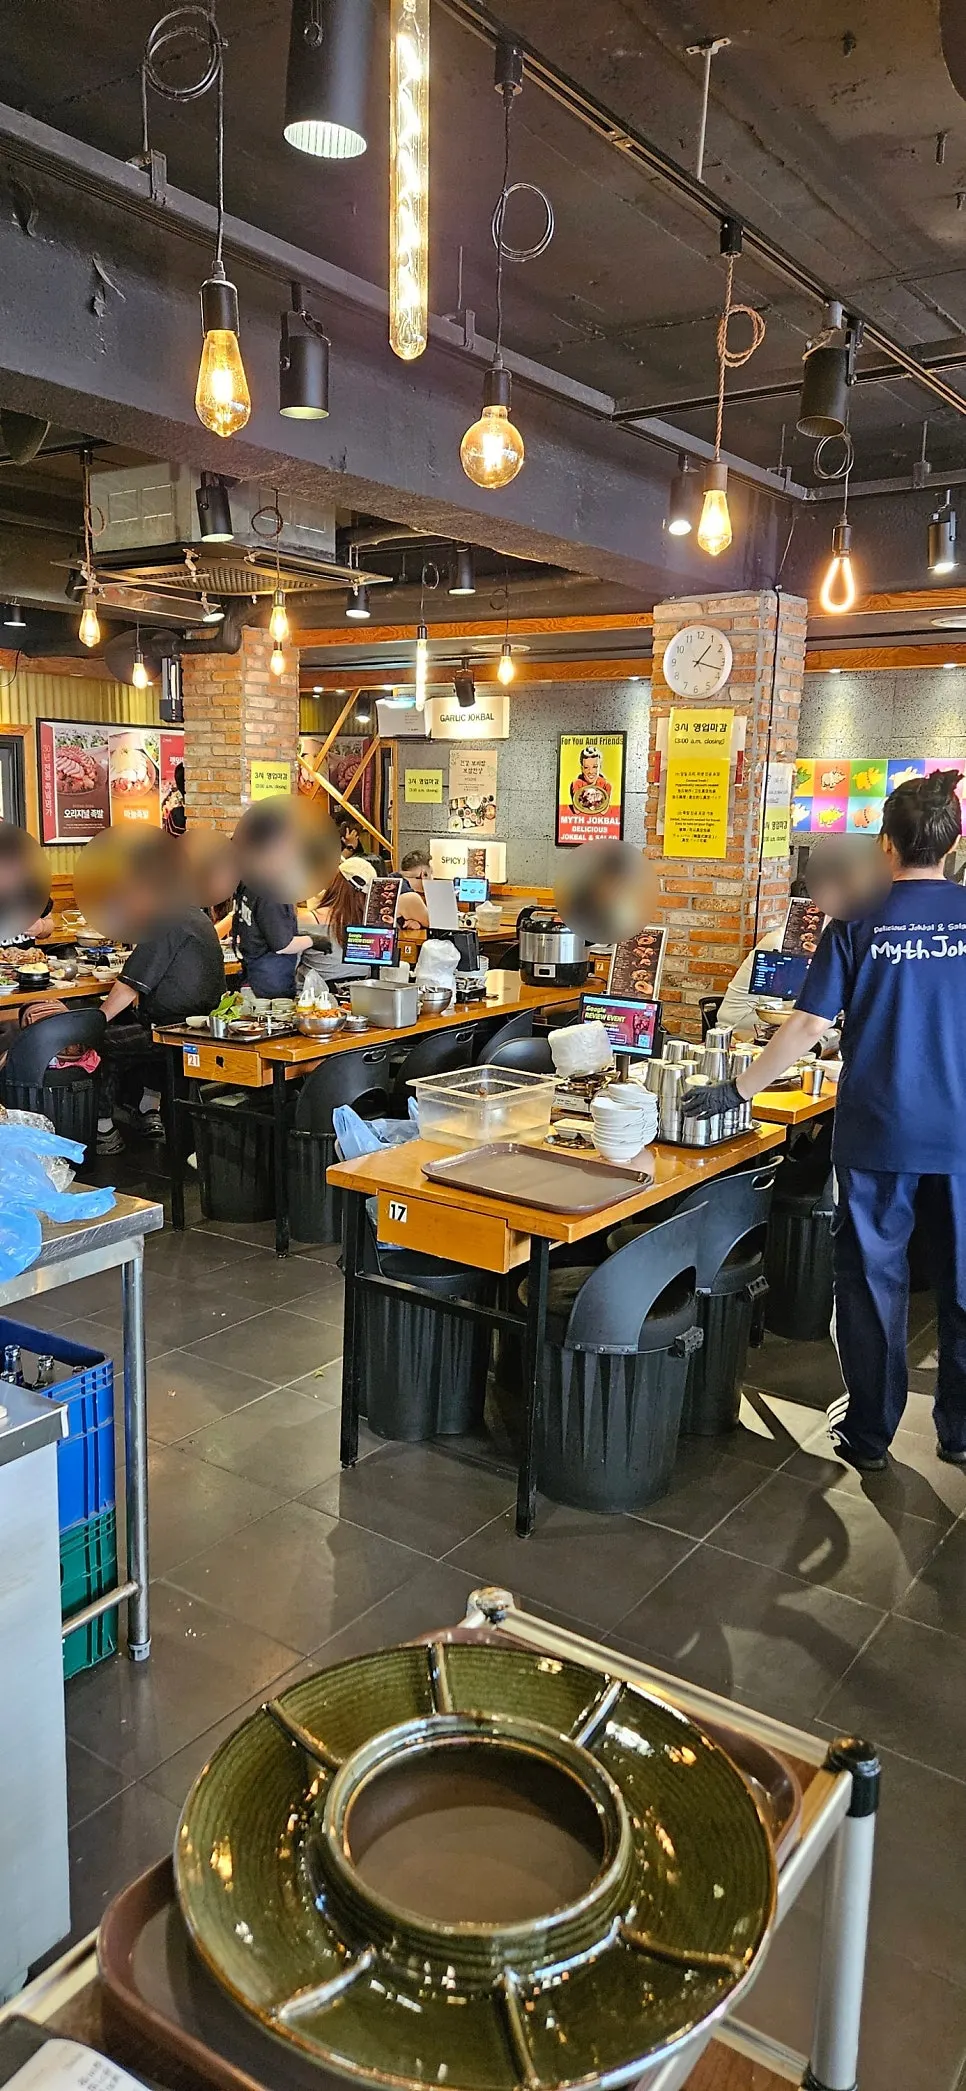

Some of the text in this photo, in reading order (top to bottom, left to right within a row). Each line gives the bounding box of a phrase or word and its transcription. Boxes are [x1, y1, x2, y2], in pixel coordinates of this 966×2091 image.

[686, 635, 693, 643] 11
[697, 631, 705, 640] 12
[676, 645, 685, 654] 10
[717, 644, 723, 653] 2
[671, 658, 677, 667] 9
[720, 657, 726, 667] 3
[674, 672, 680, 680] 8
[683, 681, 689, 690] 7
[693, 685, 699, 694] 6
[705, 681, 711, 691] 5
[440, 712, 495, 722] GARLIC JOKBAL
[674, 722, 728, 733] 3시 영업마감
[561, 737, 624, 745] For You And Friends
[63, 809, 104, 819] 오리지널 족발
[560, 815, 621, 825] MYTH JOKBAL
[571, 825, 608, 833] DELICIOUS
[441, 856, 461, 865] SPICY
[873, 924, 907, 934] Delicious
[908, 923, 935, 931] Jokbal
[937, 923, 946, 932] &
[870, 939, 930, 965] Myth
[585, 1005, 607, 1013] Google
[584, 1012, 626, 1023] REVIEW EVENT
[188, 1055, 199, 1066] 21
[390, 1203, 407, 1221] 17
